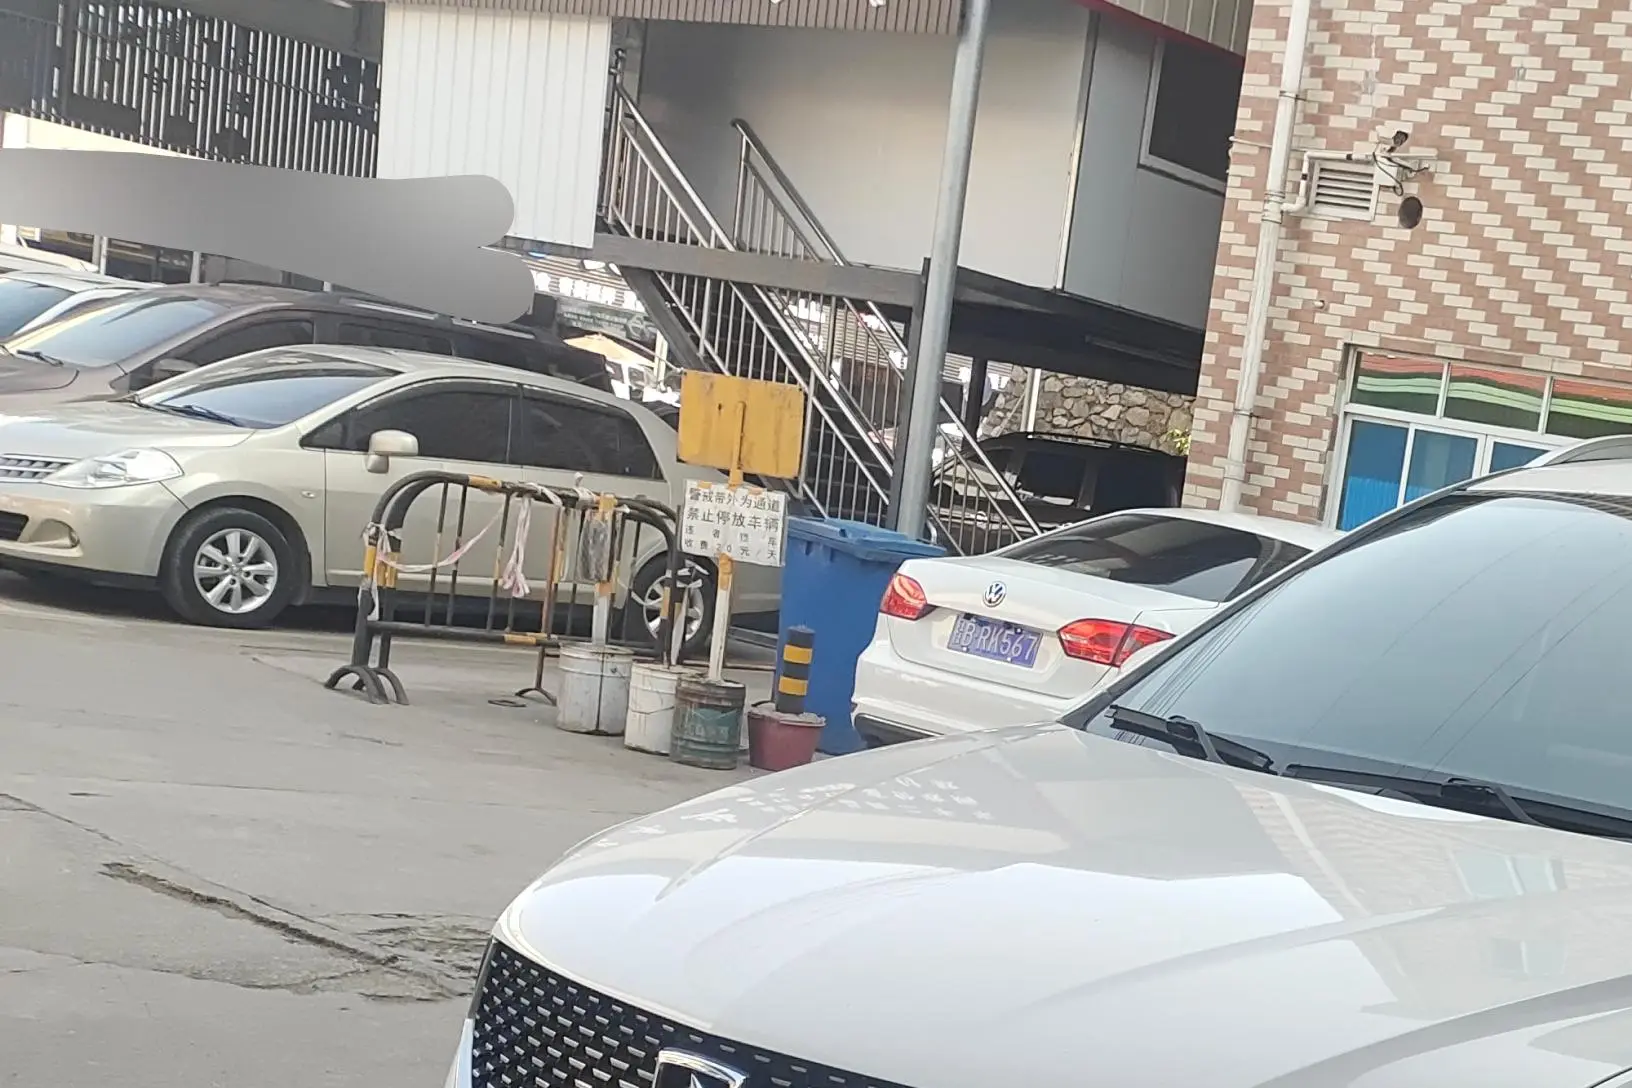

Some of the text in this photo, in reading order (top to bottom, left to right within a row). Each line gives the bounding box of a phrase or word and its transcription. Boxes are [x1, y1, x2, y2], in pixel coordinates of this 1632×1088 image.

[689, 487, 781, 513] 警戒带外为通道
[686, 507, 780, 533] 禁止停放车辆
